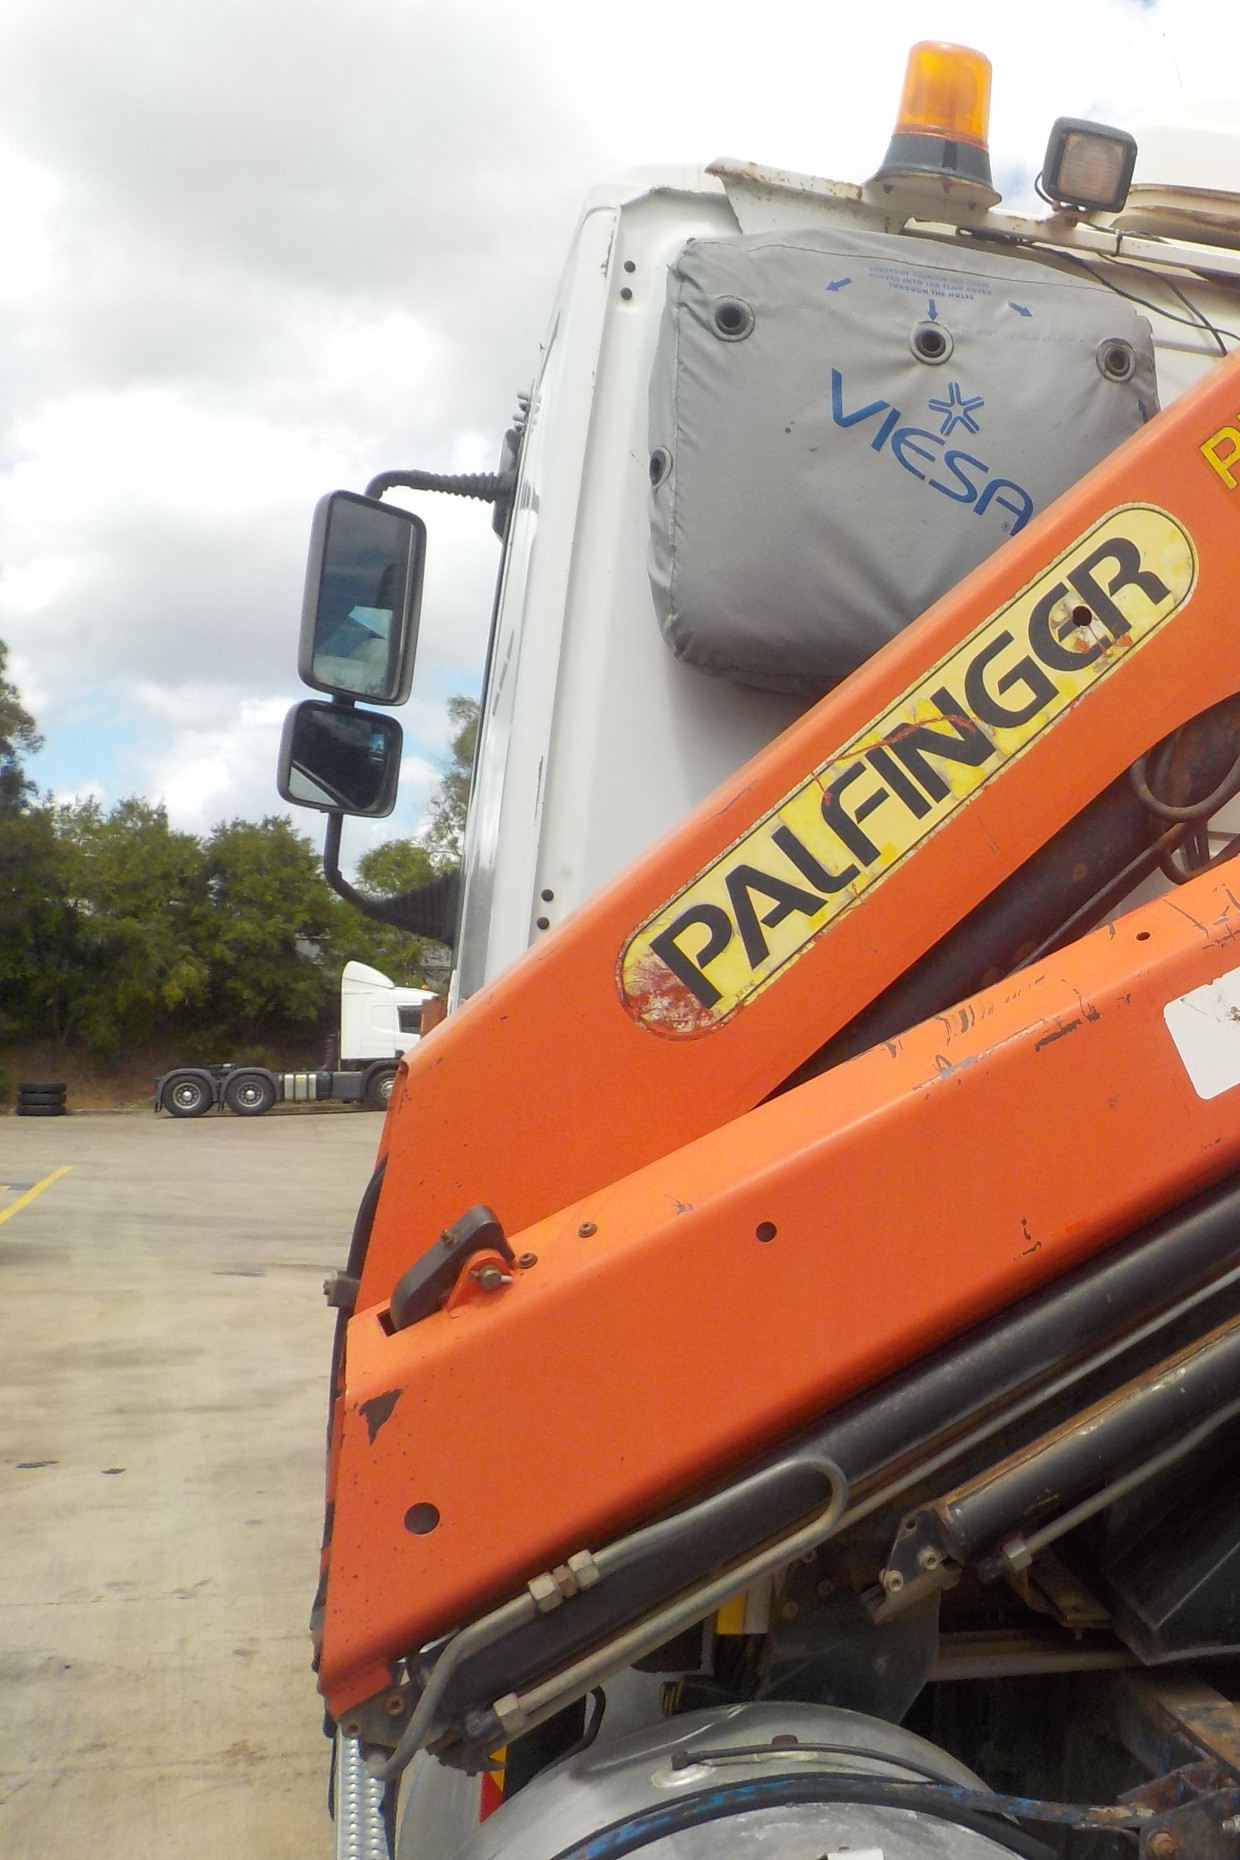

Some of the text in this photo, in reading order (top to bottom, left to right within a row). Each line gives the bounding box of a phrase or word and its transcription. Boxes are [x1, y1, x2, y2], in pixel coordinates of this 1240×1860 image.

[930, 289, 946, 298] THE
[948, 291, 975, 300] HOLES
[831, 367, 1035, 537] VIESA
[648, 536, 1173, 1010] PALFINGER
